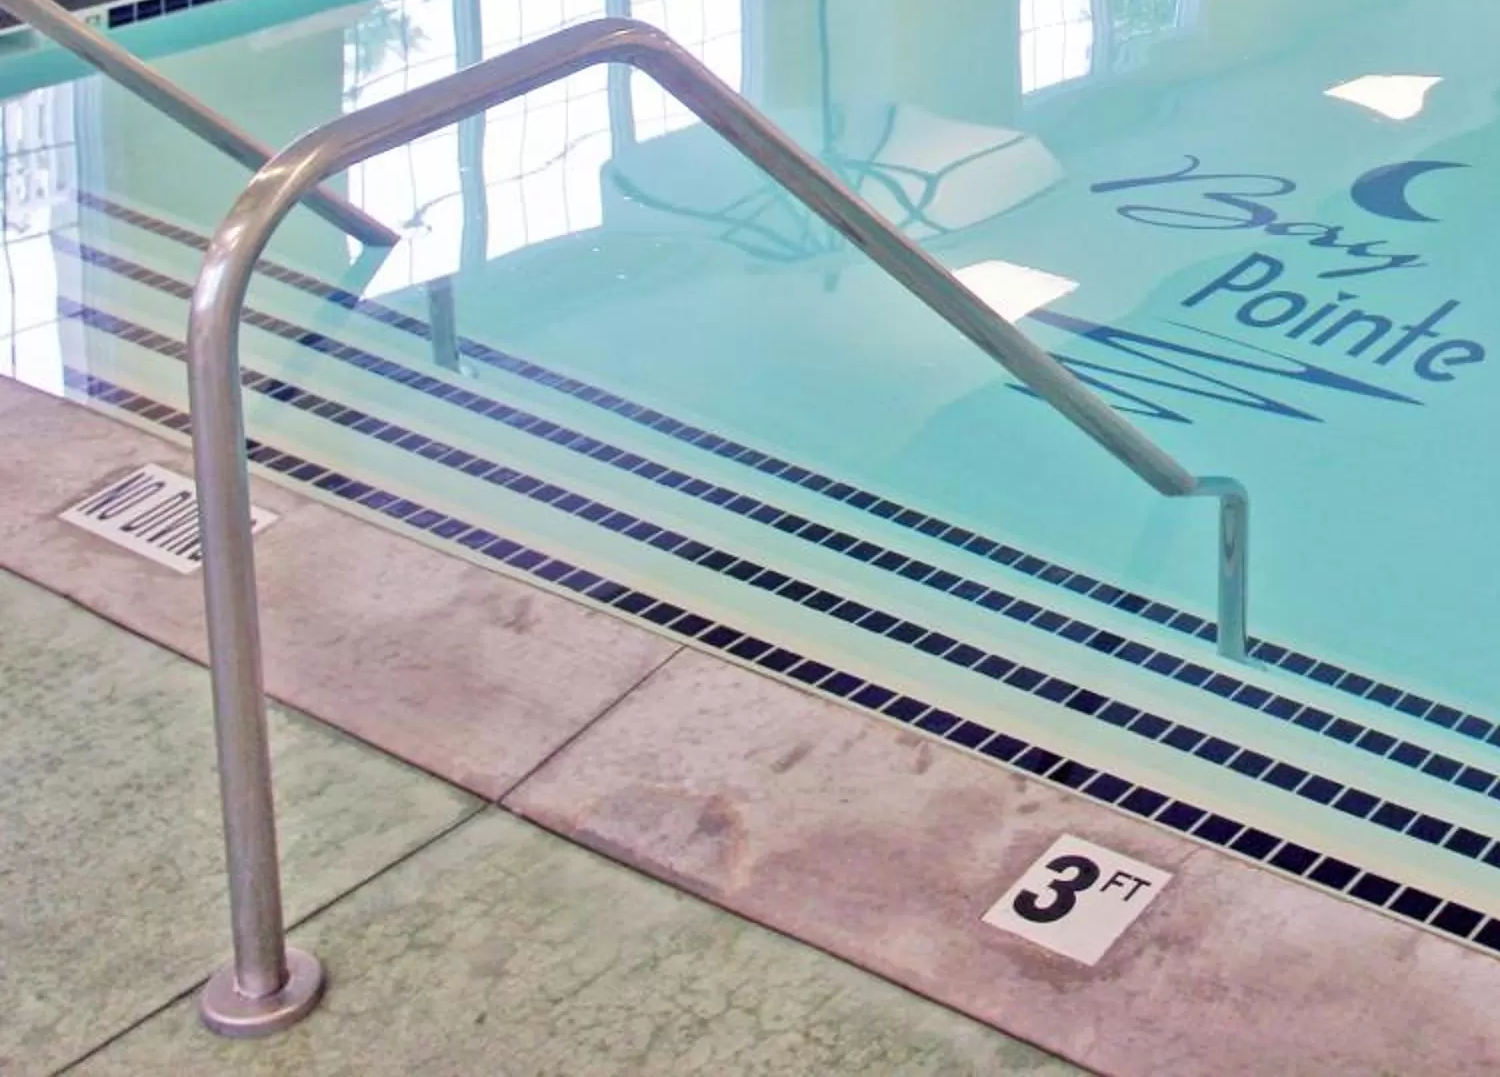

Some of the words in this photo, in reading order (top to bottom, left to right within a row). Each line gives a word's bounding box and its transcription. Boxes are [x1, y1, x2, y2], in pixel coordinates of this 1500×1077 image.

[1090, 154, 1427, 278] Bay
[1181, 252, 1486, 382] Pointe
[77, 472, 167, 520] NO
[120, 490, 256, 562] DIVI
[1013, 854, 1101, 923] 3
[1100, 870, 1152, 902] FT
